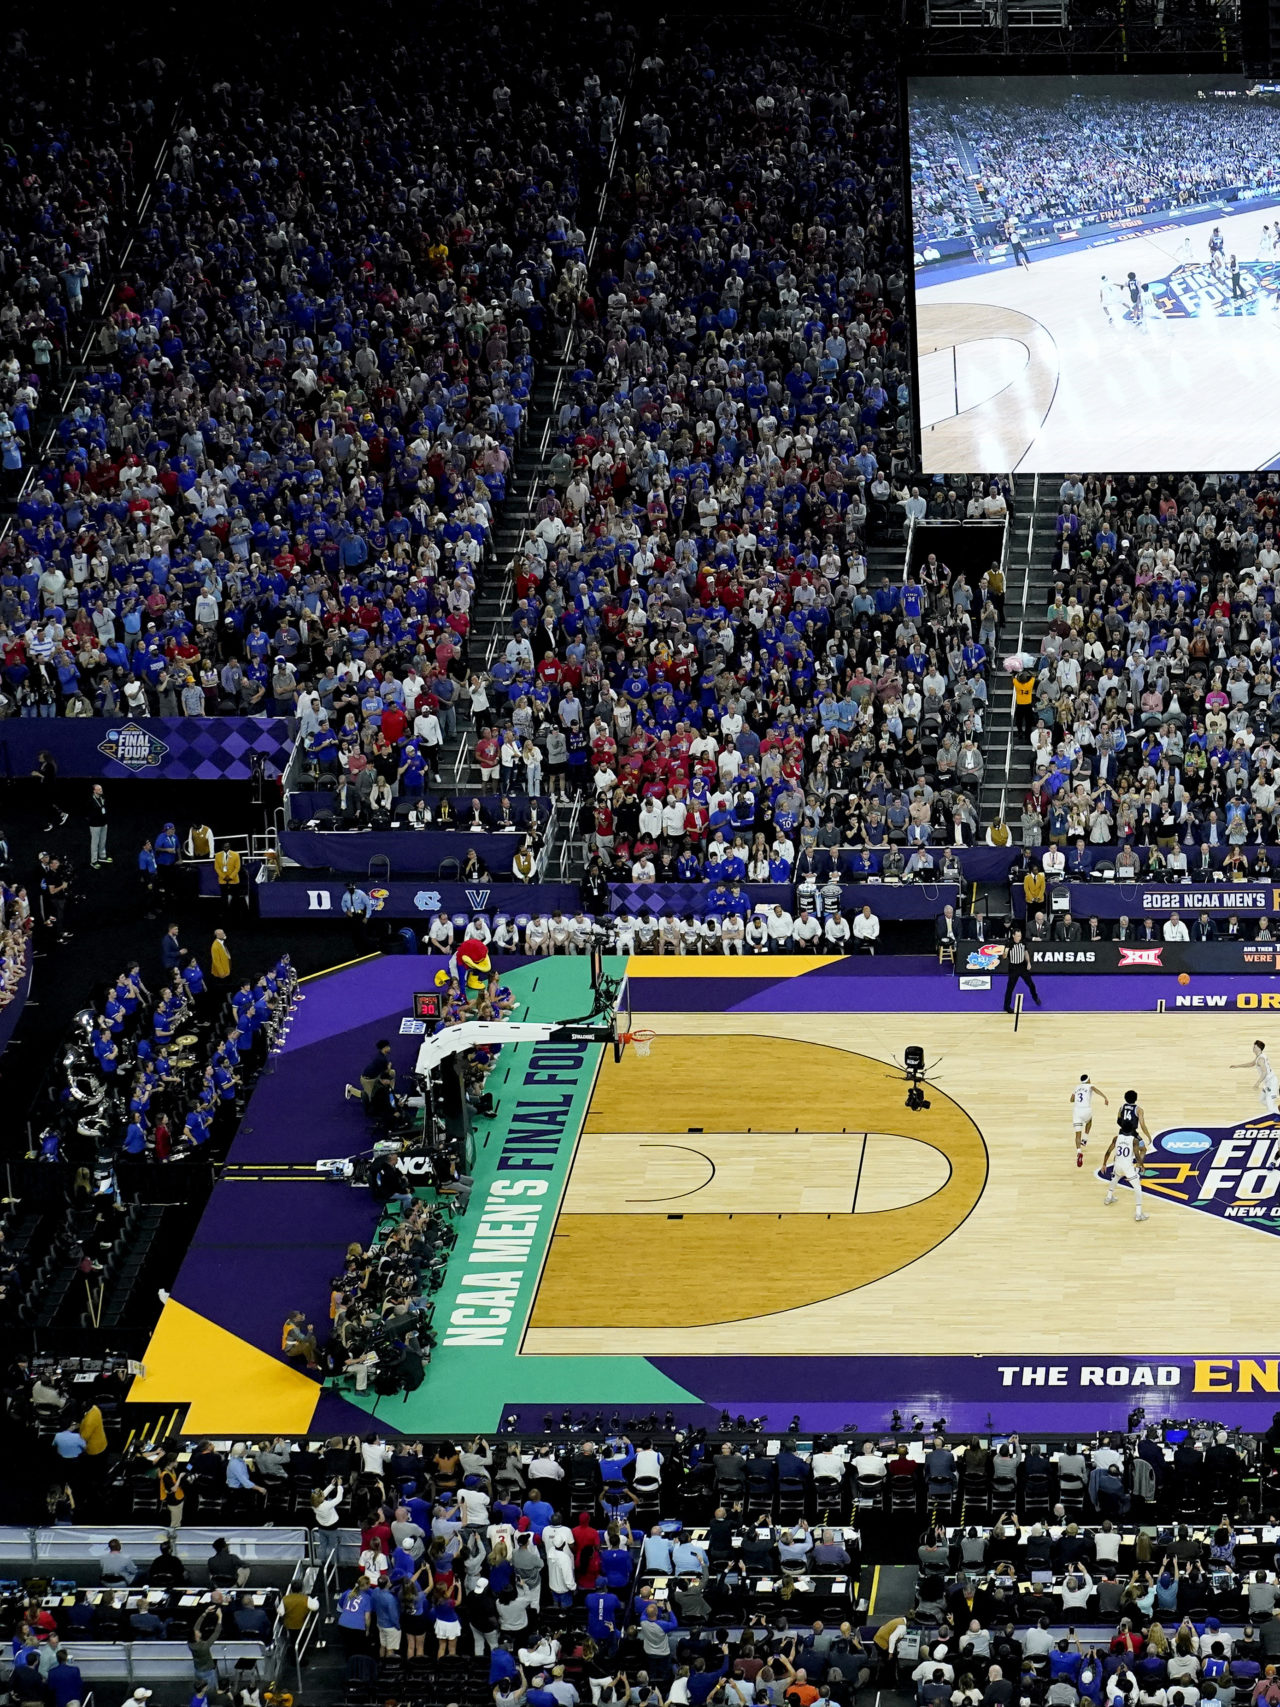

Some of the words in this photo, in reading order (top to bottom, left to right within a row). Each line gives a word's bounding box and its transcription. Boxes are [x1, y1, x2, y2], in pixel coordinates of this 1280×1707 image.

[118, 735, 150, 746] FINAL
[118, 746, 149, 758] FOUR
[1143, 894, 1180, 908] 2022
[1183, 893, 1220, 908] NCAA
[1223, 892, 1266, 907] MEN'S
[1033, 951, 1096, 962] KANSAS
[1243, 954, 1273, 962] WERE
[1175, 995, 1228, 1006] NEW
[420, 1004, 435, 1015] 30
[523, 1035, 590, 1085] FOU
[1077, 1092, 1083, 1103] 3
[1123, 1109, 1132, 1121] 14
[497, 1094, 574, 1171] FINAL
[1166, 1141, 1210, 1149] NCAA
[1116, 1146, 1130, 1158] 30
[1224, 1207, 1270, 1217] NEW
[468, 1179, 549, 1263] MEN'S
[442, 1270, 524, 1346] NCAA
[997, 1366, 1069, 1386] THE
[1080, 1366, 1181, 1386] ROAD
[345, 1599, 360, 1612] 15
[1212, 1665, 1217, 1677] 1
